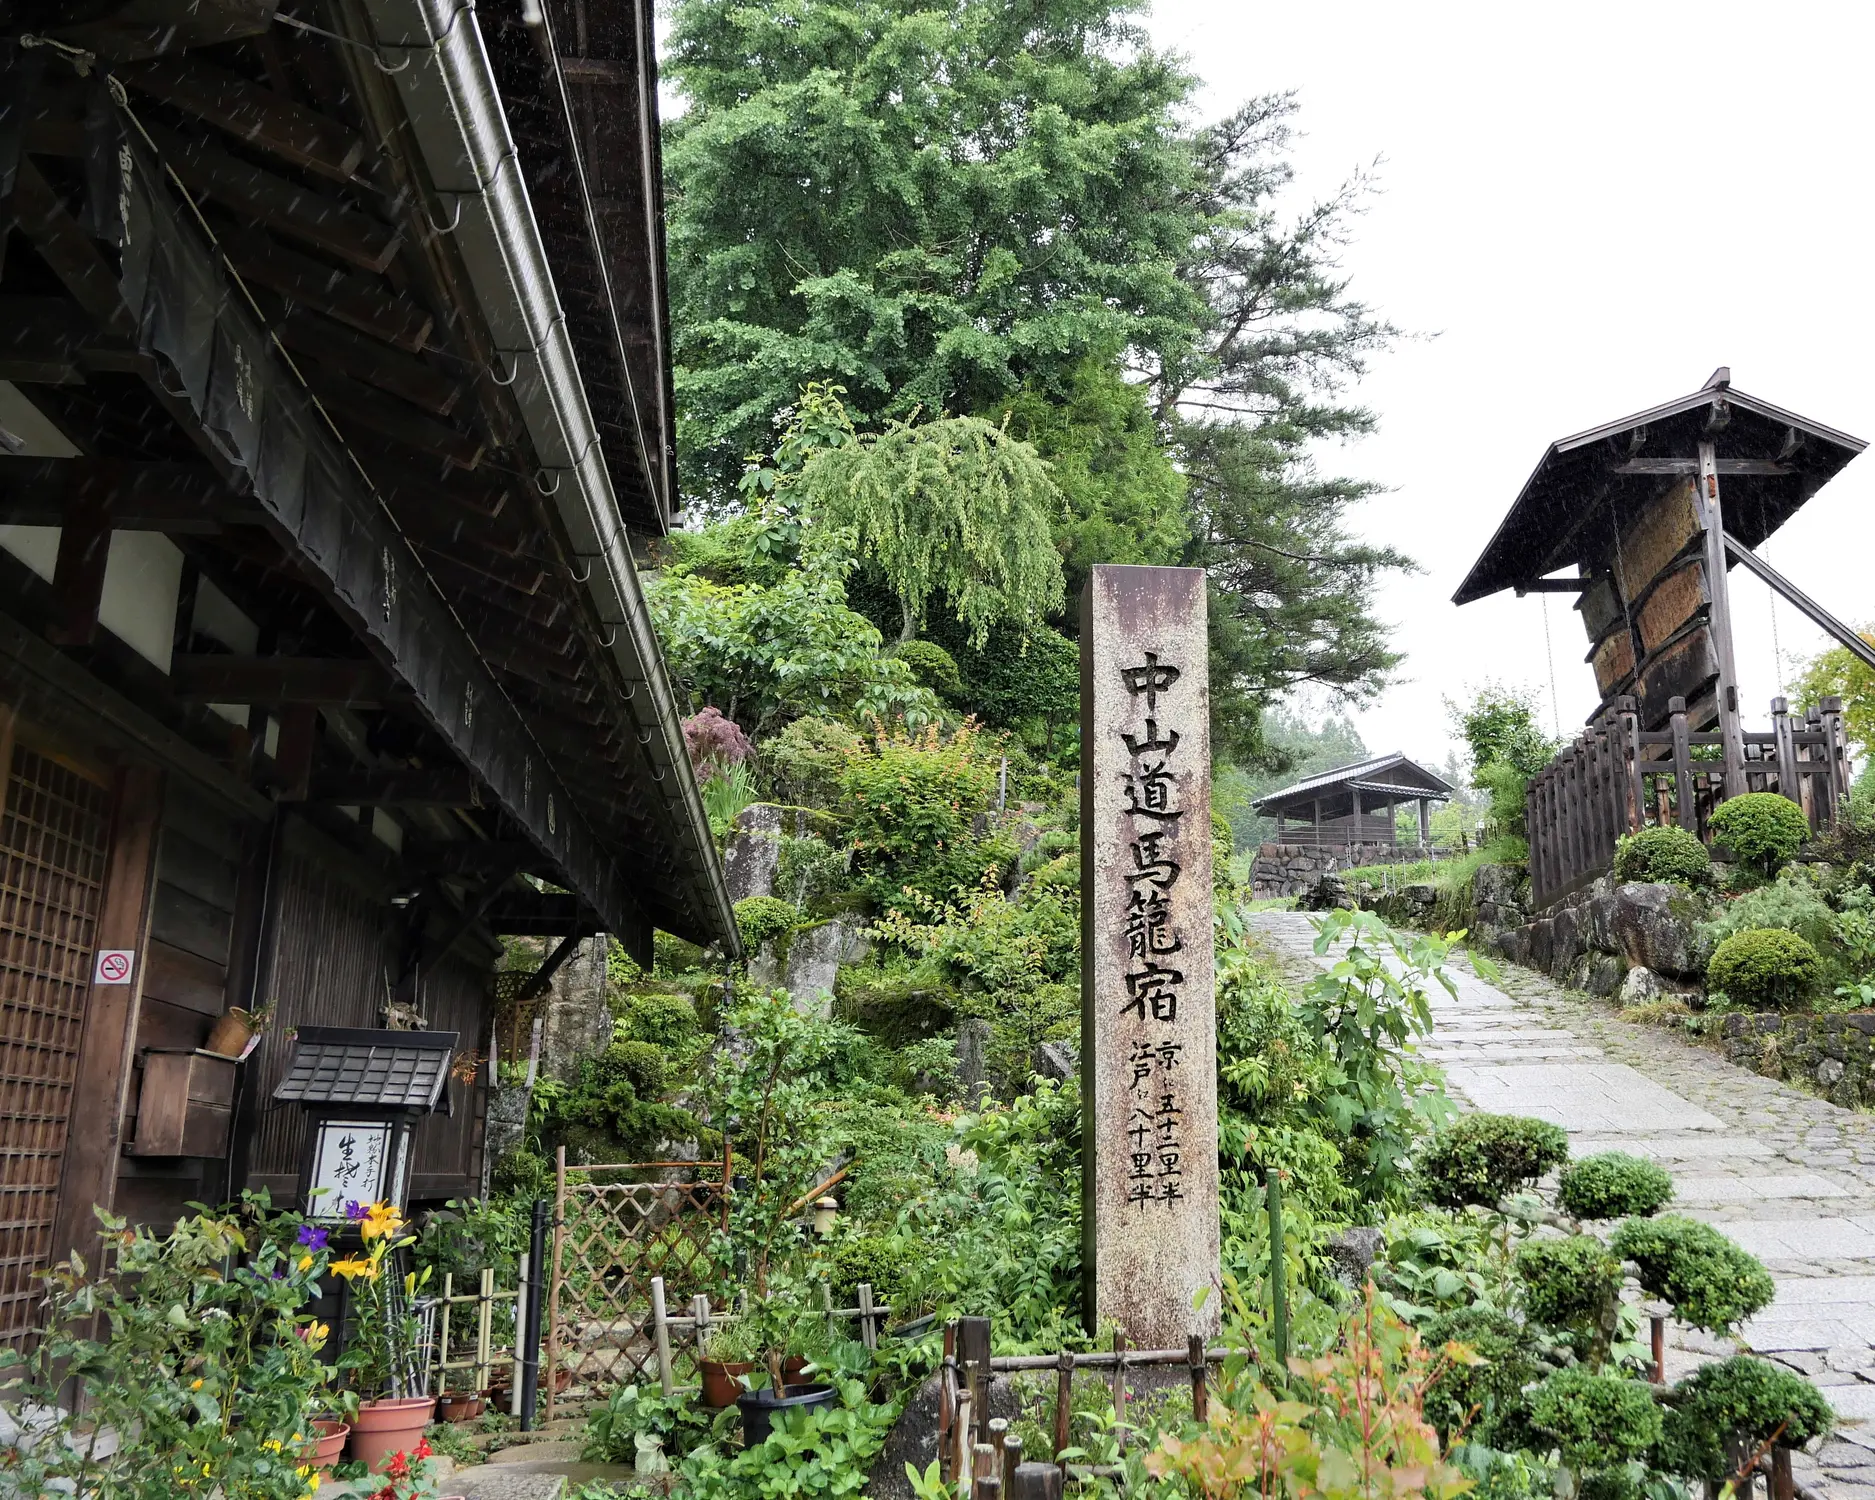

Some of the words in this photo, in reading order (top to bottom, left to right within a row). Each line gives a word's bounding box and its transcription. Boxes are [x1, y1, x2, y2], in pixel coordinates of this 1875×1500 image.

[1119, 651, 1185, 1022] 中山道馬籠宿
